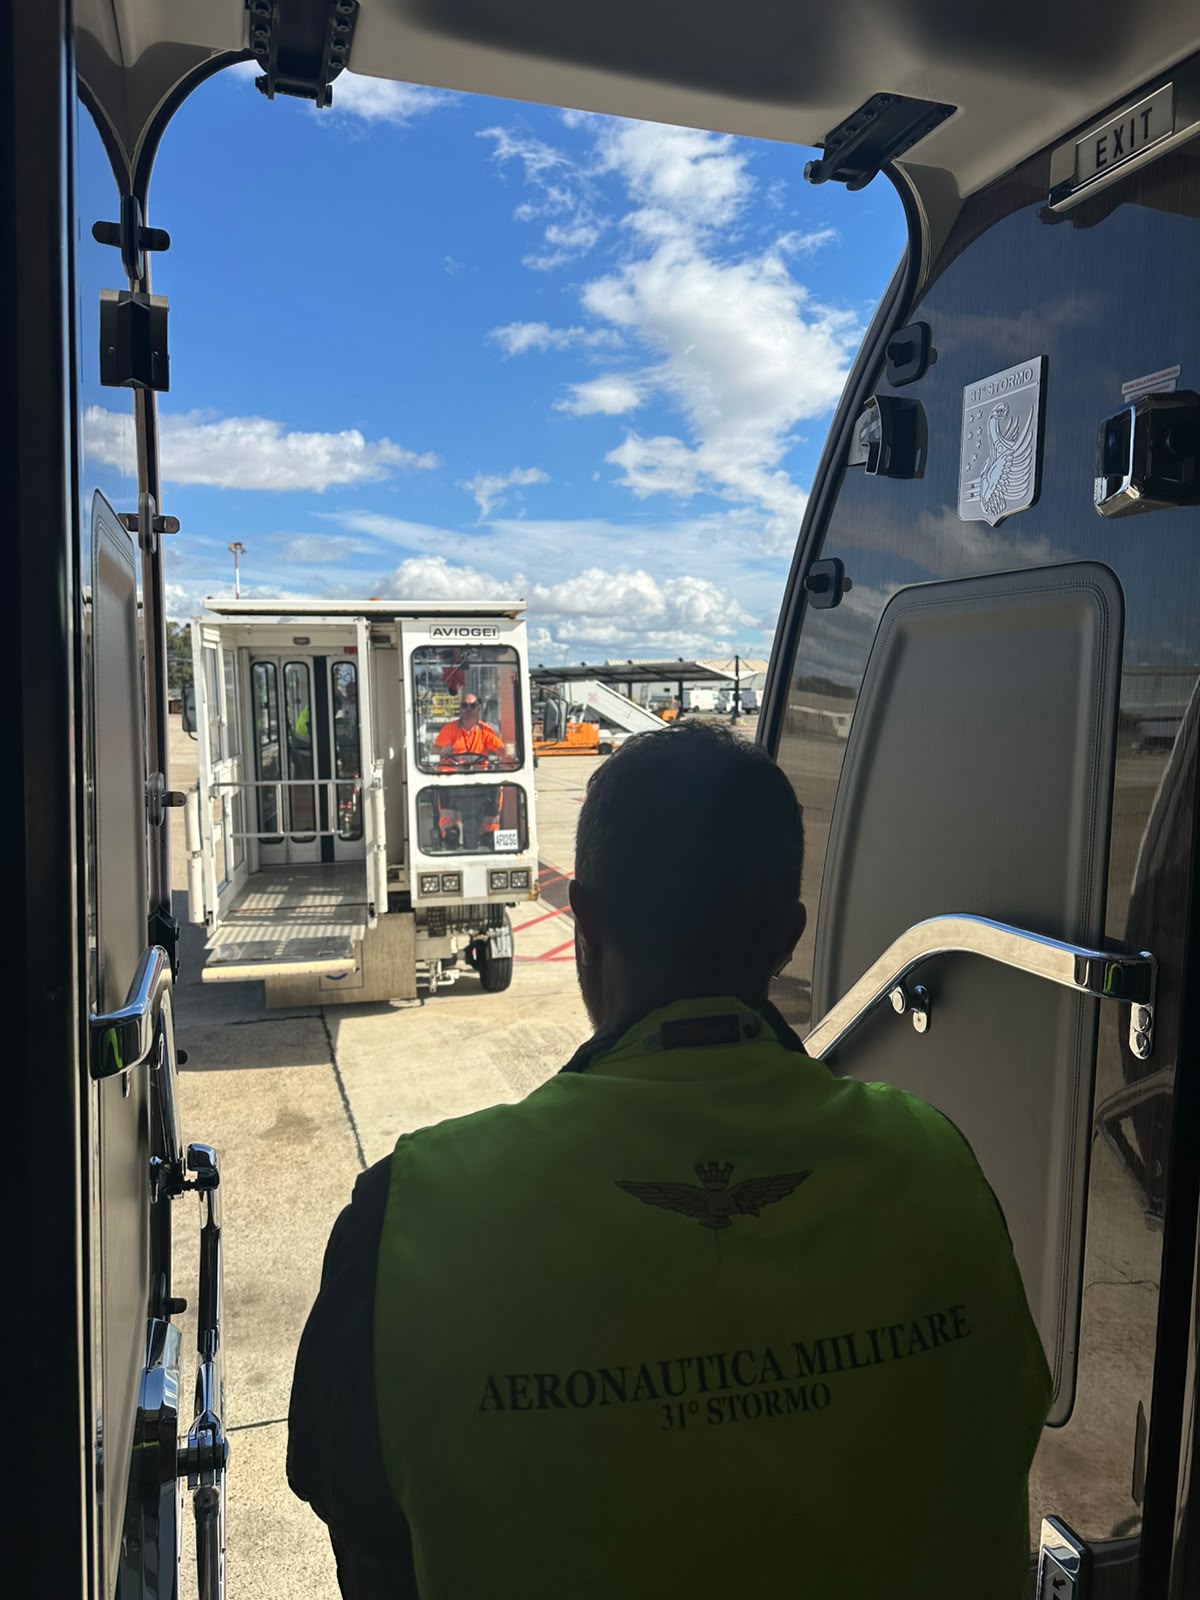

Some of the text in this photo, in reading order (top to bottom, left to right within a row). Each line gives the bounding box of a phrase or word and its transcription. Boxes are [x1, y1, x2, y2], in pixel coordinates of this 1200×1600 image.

[1095, 106, 1153, 169] EXIT
[987, 368, 1034, 396] STORMO
[432, 627, 497, 637] AVIOGEI
[478, 1304, 973, 1412] AERONAUTICA MILITARE
[661, 1382, 832, 1432] 31° STORMO
